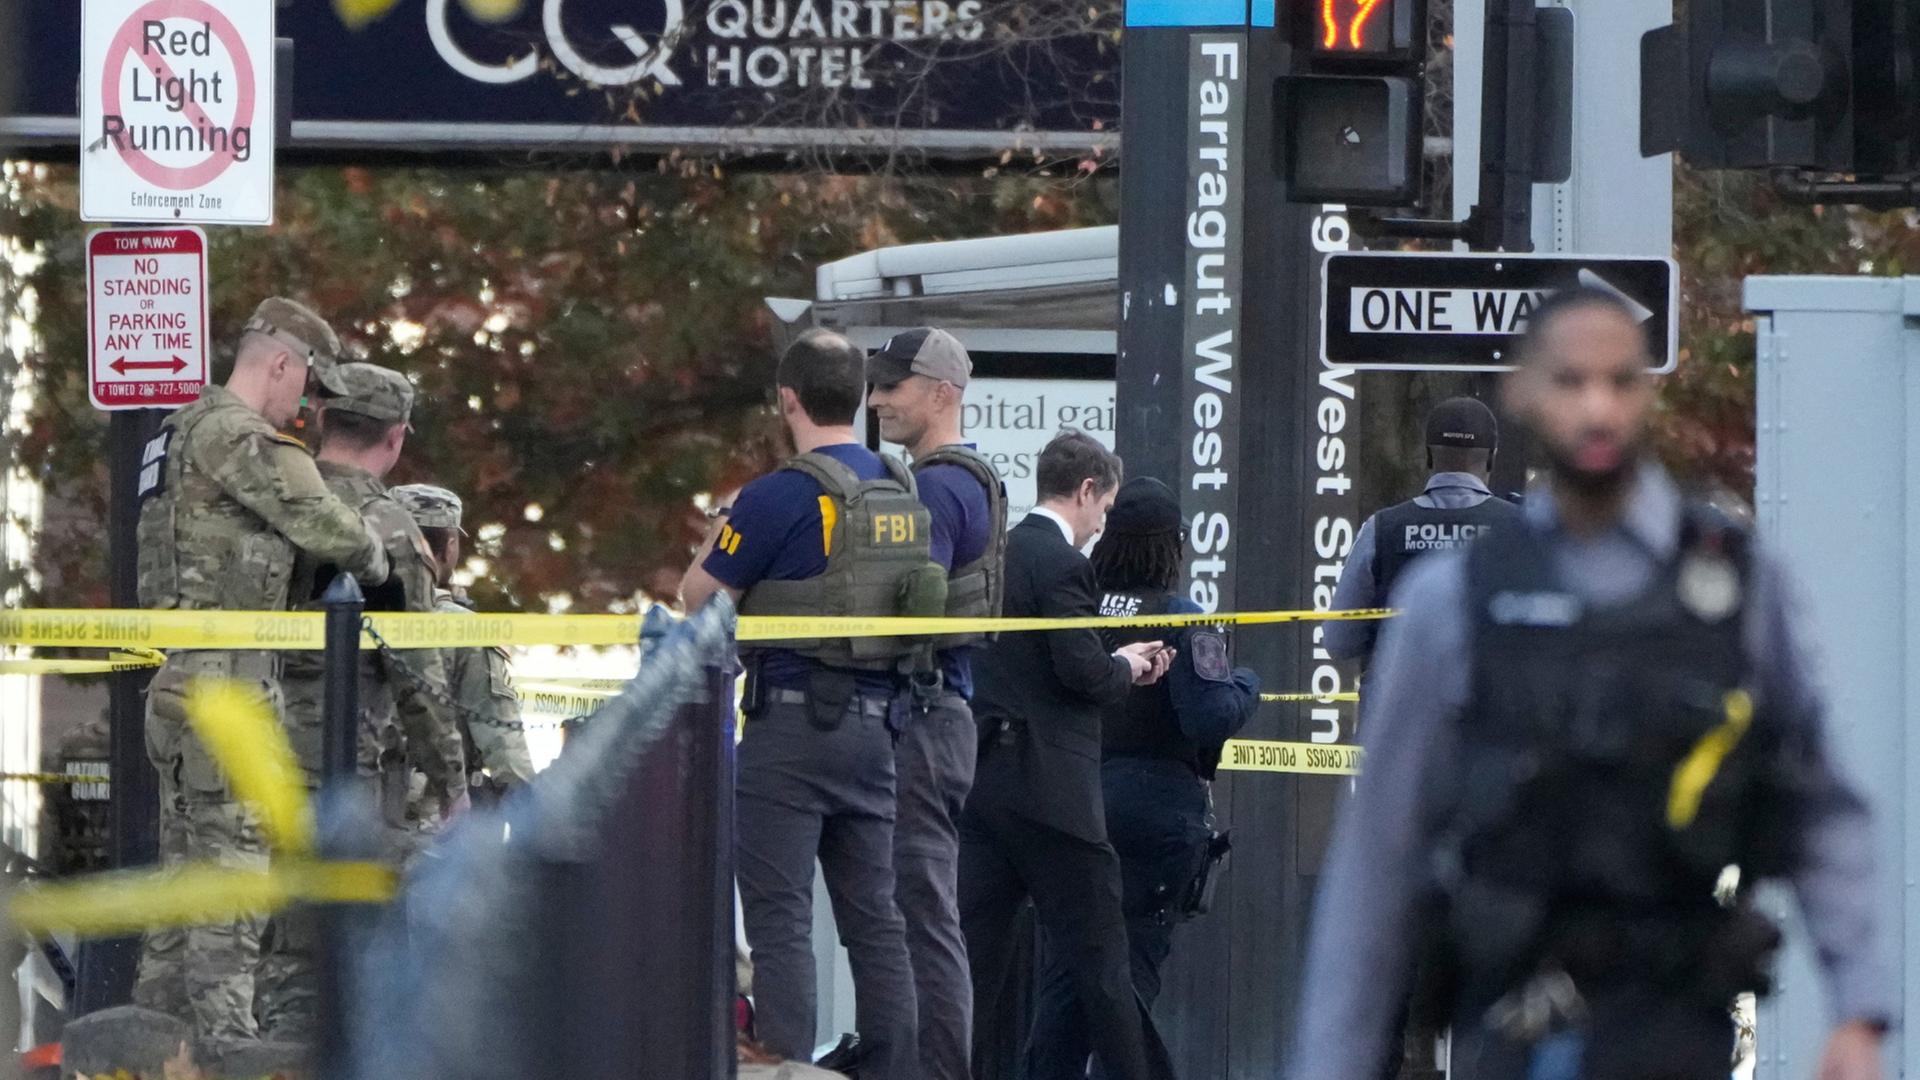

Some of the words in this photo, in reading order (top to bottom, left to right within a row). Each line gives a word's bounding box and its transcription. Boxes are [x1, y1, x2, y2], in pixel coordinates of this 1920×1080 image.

[706, 0, 984, 41] QUARTERS
[143, 20, 211, 57] Red
[706, 45, 872, 88] HOTEL
[132, 67, 222, 112] Light
[102, 115, 251, 162] Running
[1187, 42, 1239, 315] Farragut
[131, 192, 194, 209] Enforcement
[199, 194, 222, 209] Zone
[115, 238, 138, 249] TOW
[134, 258, 159, 275] NO
[104, 278, 192, 296] STANDING
[140, 299, 154, 310] OR
[1361, 290, 1452, 331] ONE
[109, 313, 186, 330] PARKING
[104, 333, 142, 351] ANY
[152, 332, 193, 350] TIME
[98, 384, 105, 396] IF
[109, 383, 135, 396] TOWED
[1193, 329, 1233, 491] West
[874, 514, 916, 543] FBI
[1405, 540, 1454, 550] MOTOR
[1189, 511, 1230, 616] Sta
[1311, 516, 1353, 744] Staon
[1233, 744, 1256, 765] LINE
[1259, 745, 1296, 767] POLICE
[1307, 747, 1342, 769] CROSS
